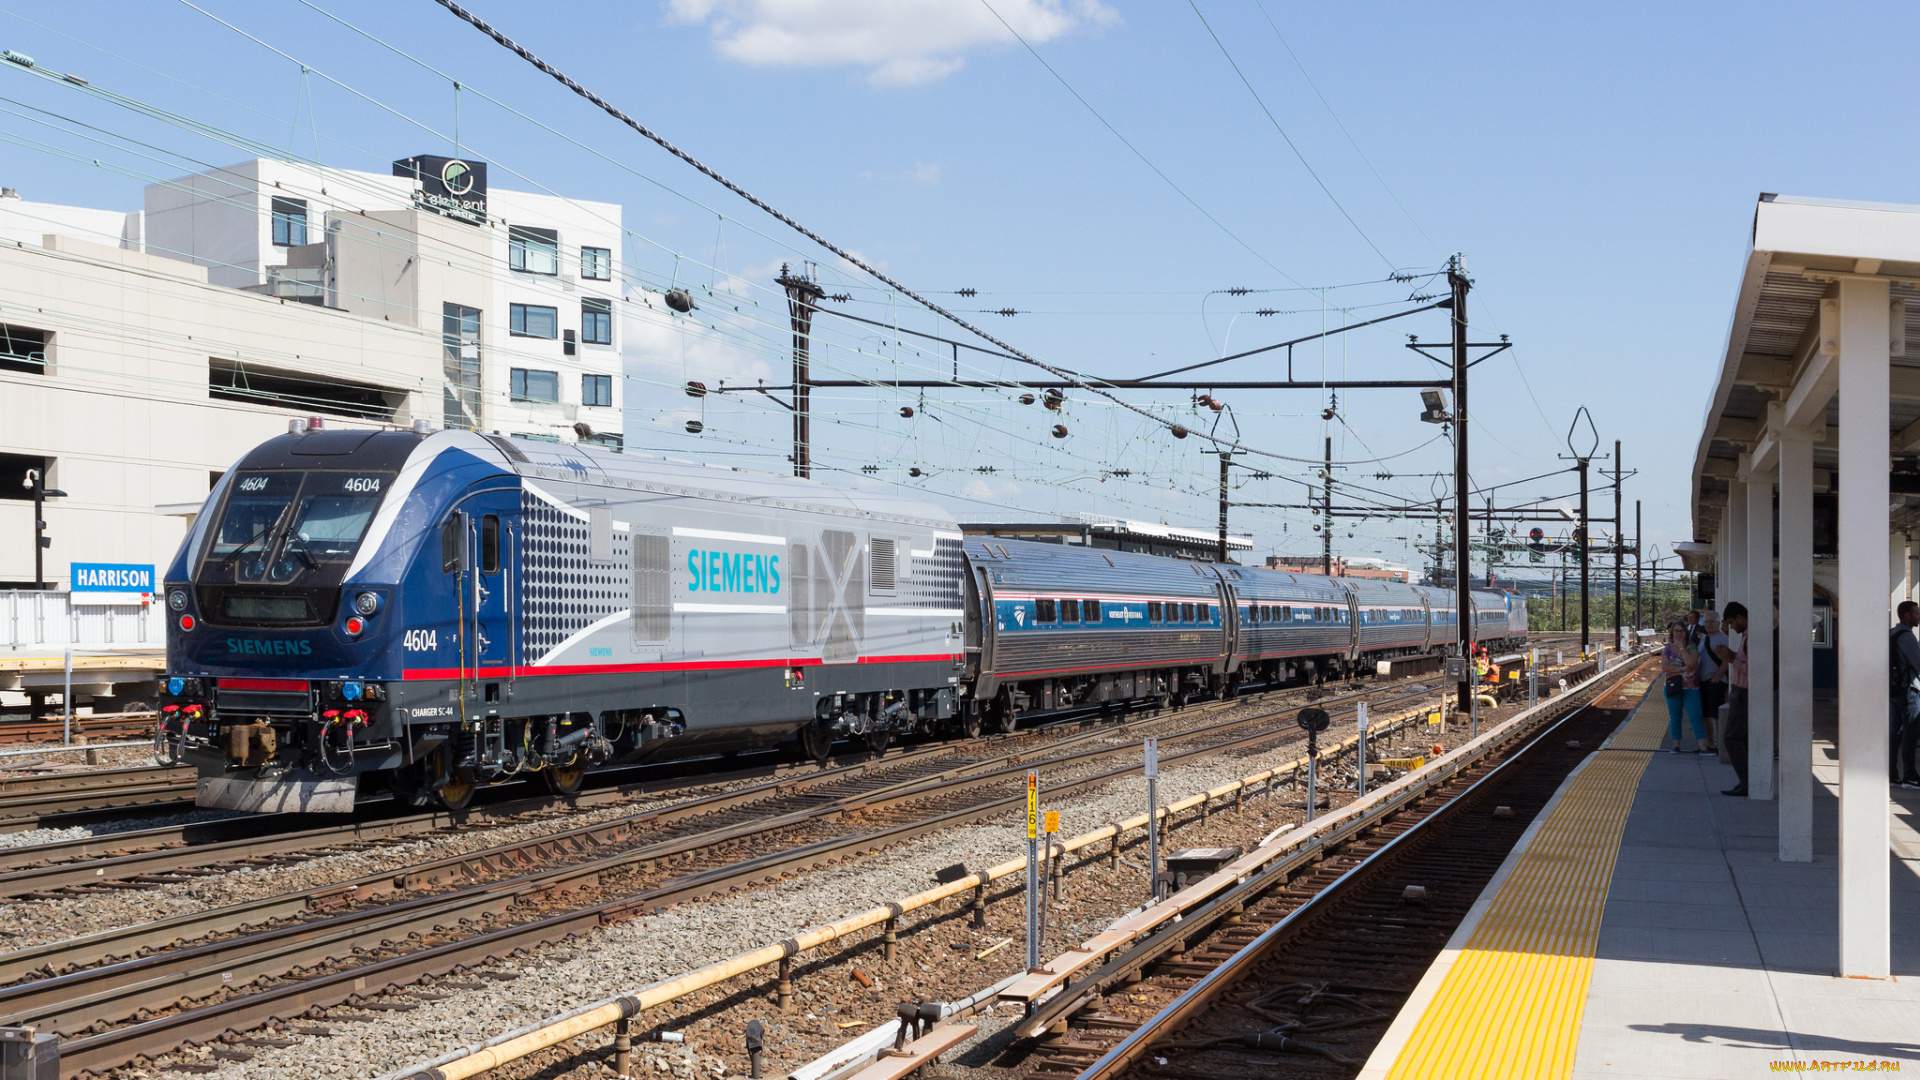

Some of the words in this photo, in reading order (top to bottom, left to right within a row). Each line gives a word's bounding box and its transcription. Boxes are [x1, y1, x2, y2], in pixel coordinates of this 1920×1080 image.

[240, 477, 269, 491] 4604
[344, 478, 380, 492] 4604
[78, 569, 149, 587] HARRISON
[687, 549, 780, 595] SIEMENS
[227, 638, 312, 655] SIEMENS
[403, 629, 437, 651] 4604
[589, 647, 613, 657] SIEMENS
[411, 707, 437, 717] CHARGER
[438, 706, 453, 716] SC-44
[1147, 738, 1154, 747] T
